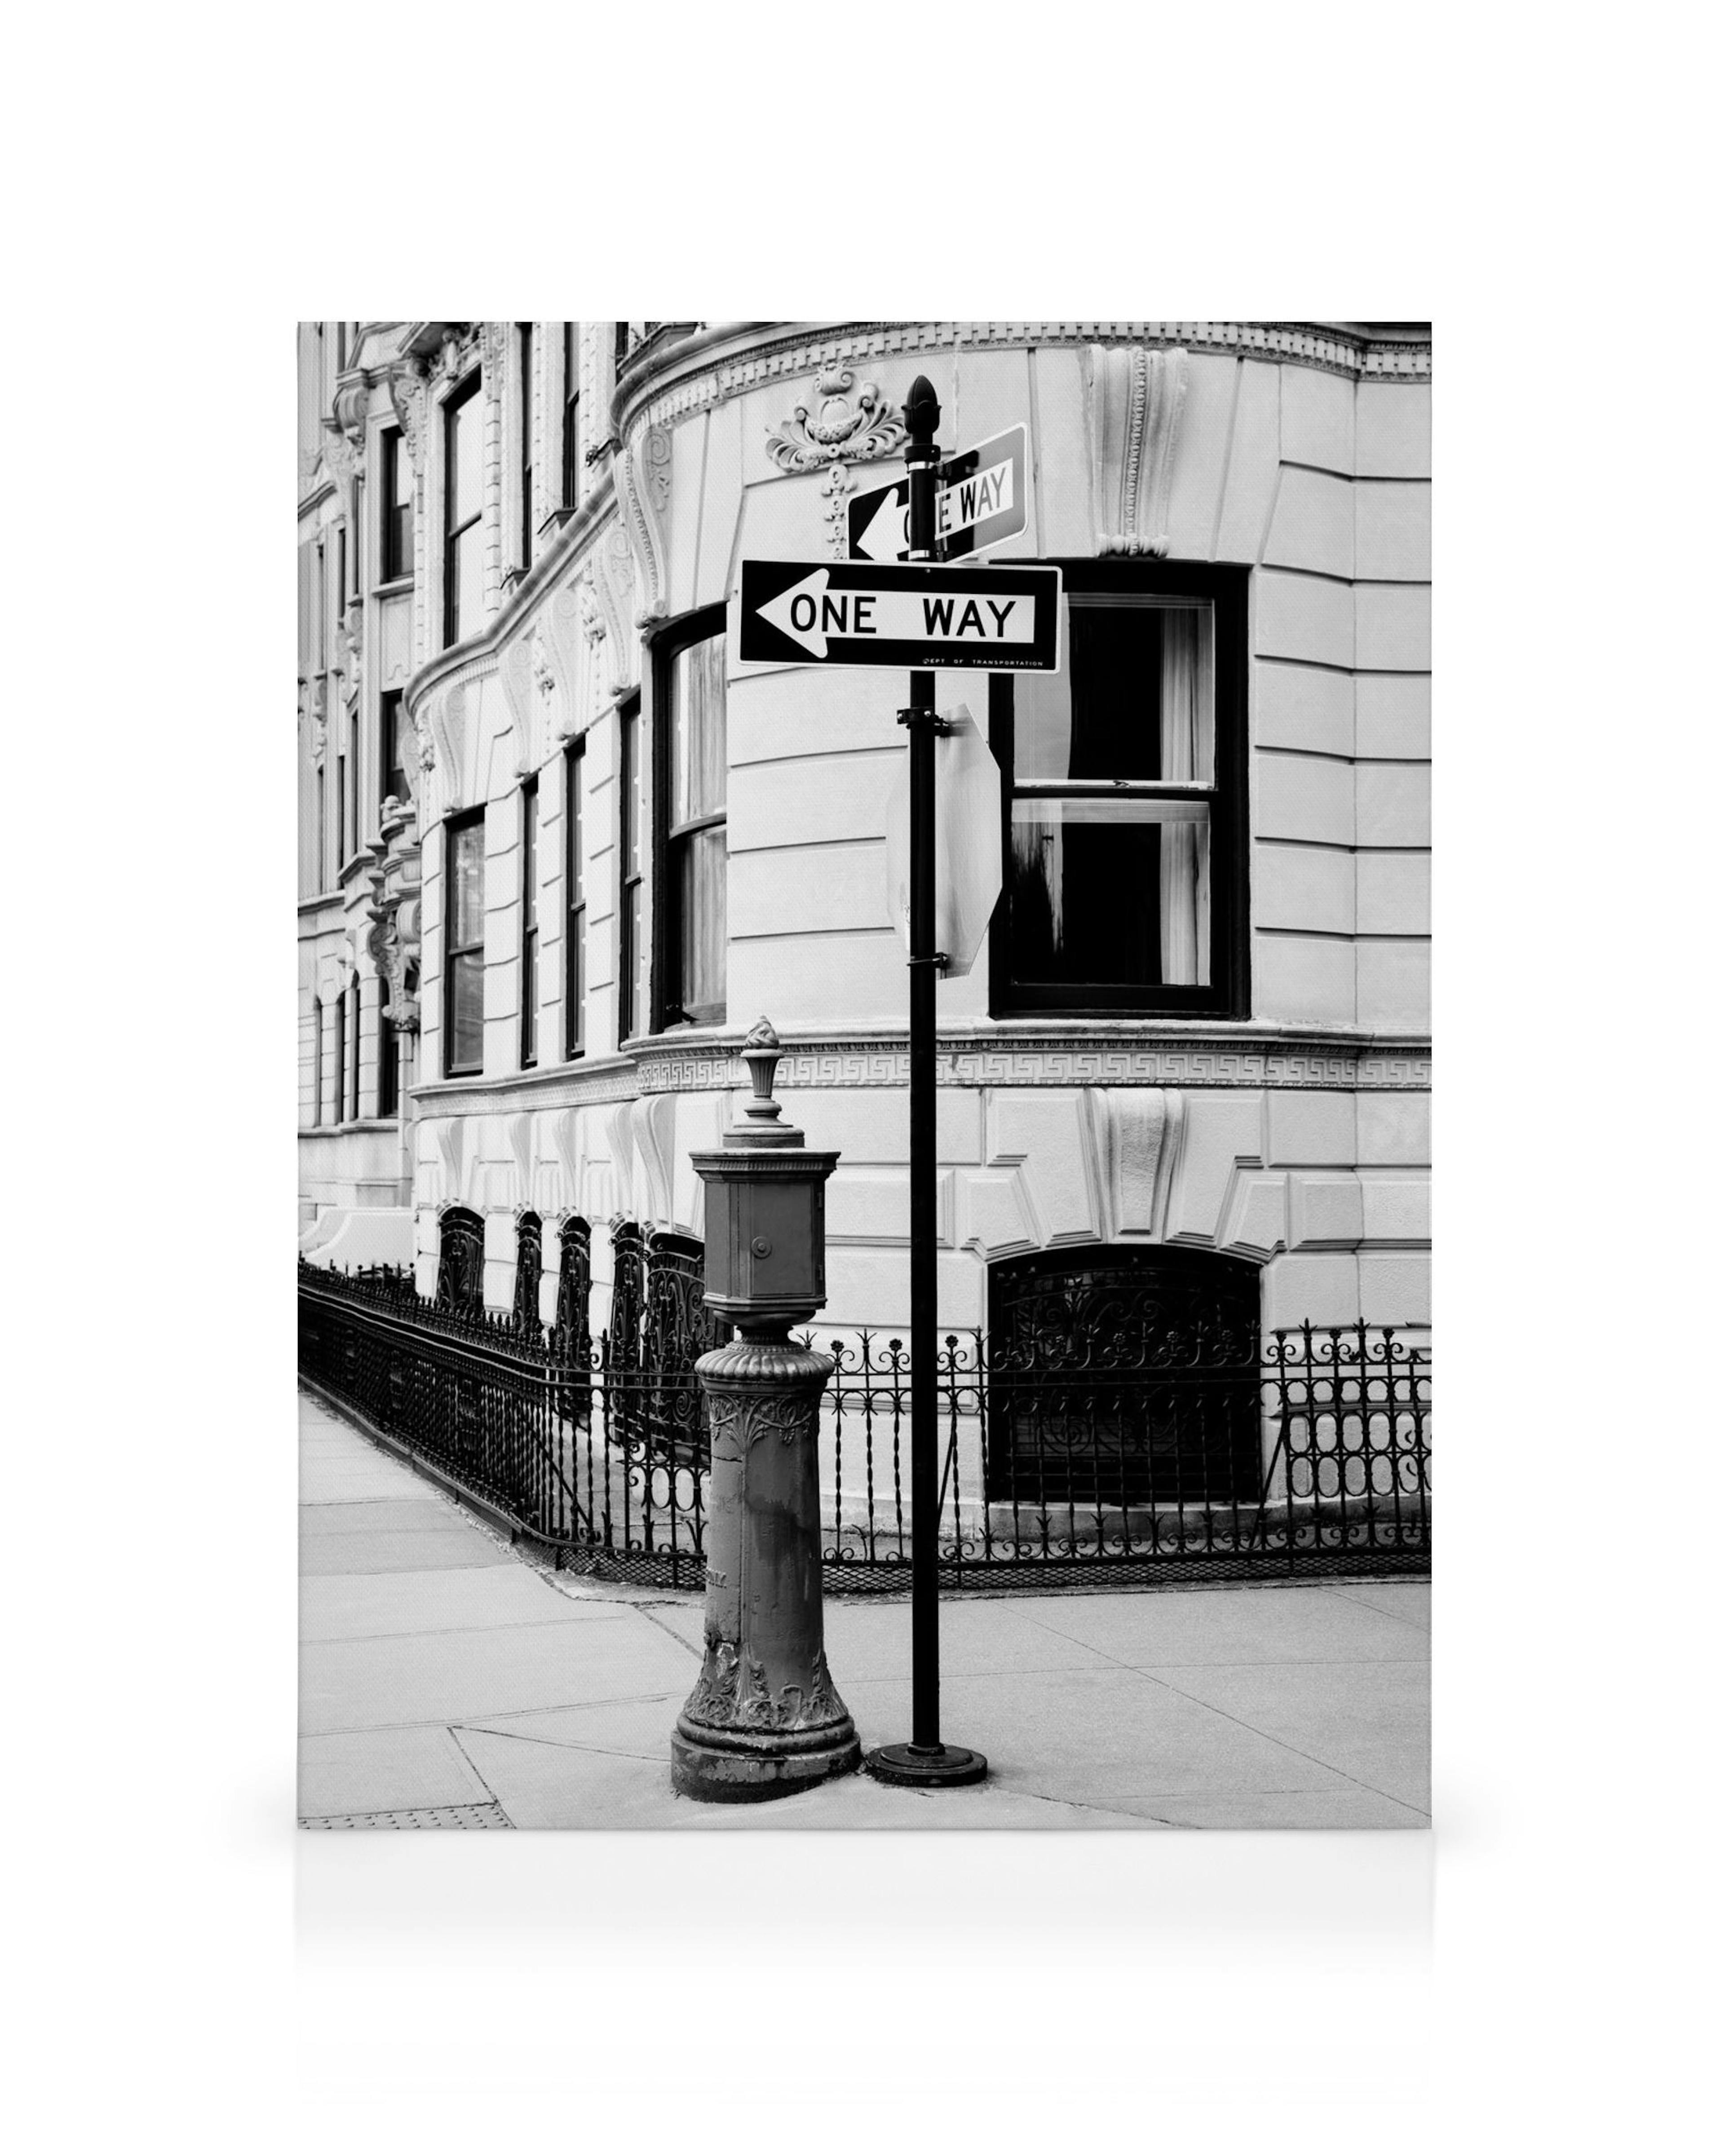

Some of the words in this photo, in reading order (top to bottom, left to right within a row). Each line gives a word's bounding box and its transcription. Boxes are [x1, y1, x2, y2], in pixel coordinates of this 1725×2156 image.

[960, 467, 1006, 524] WAY
[791, 594, 876, 634] ONE
[923, 598, 1016, 637] WAY
